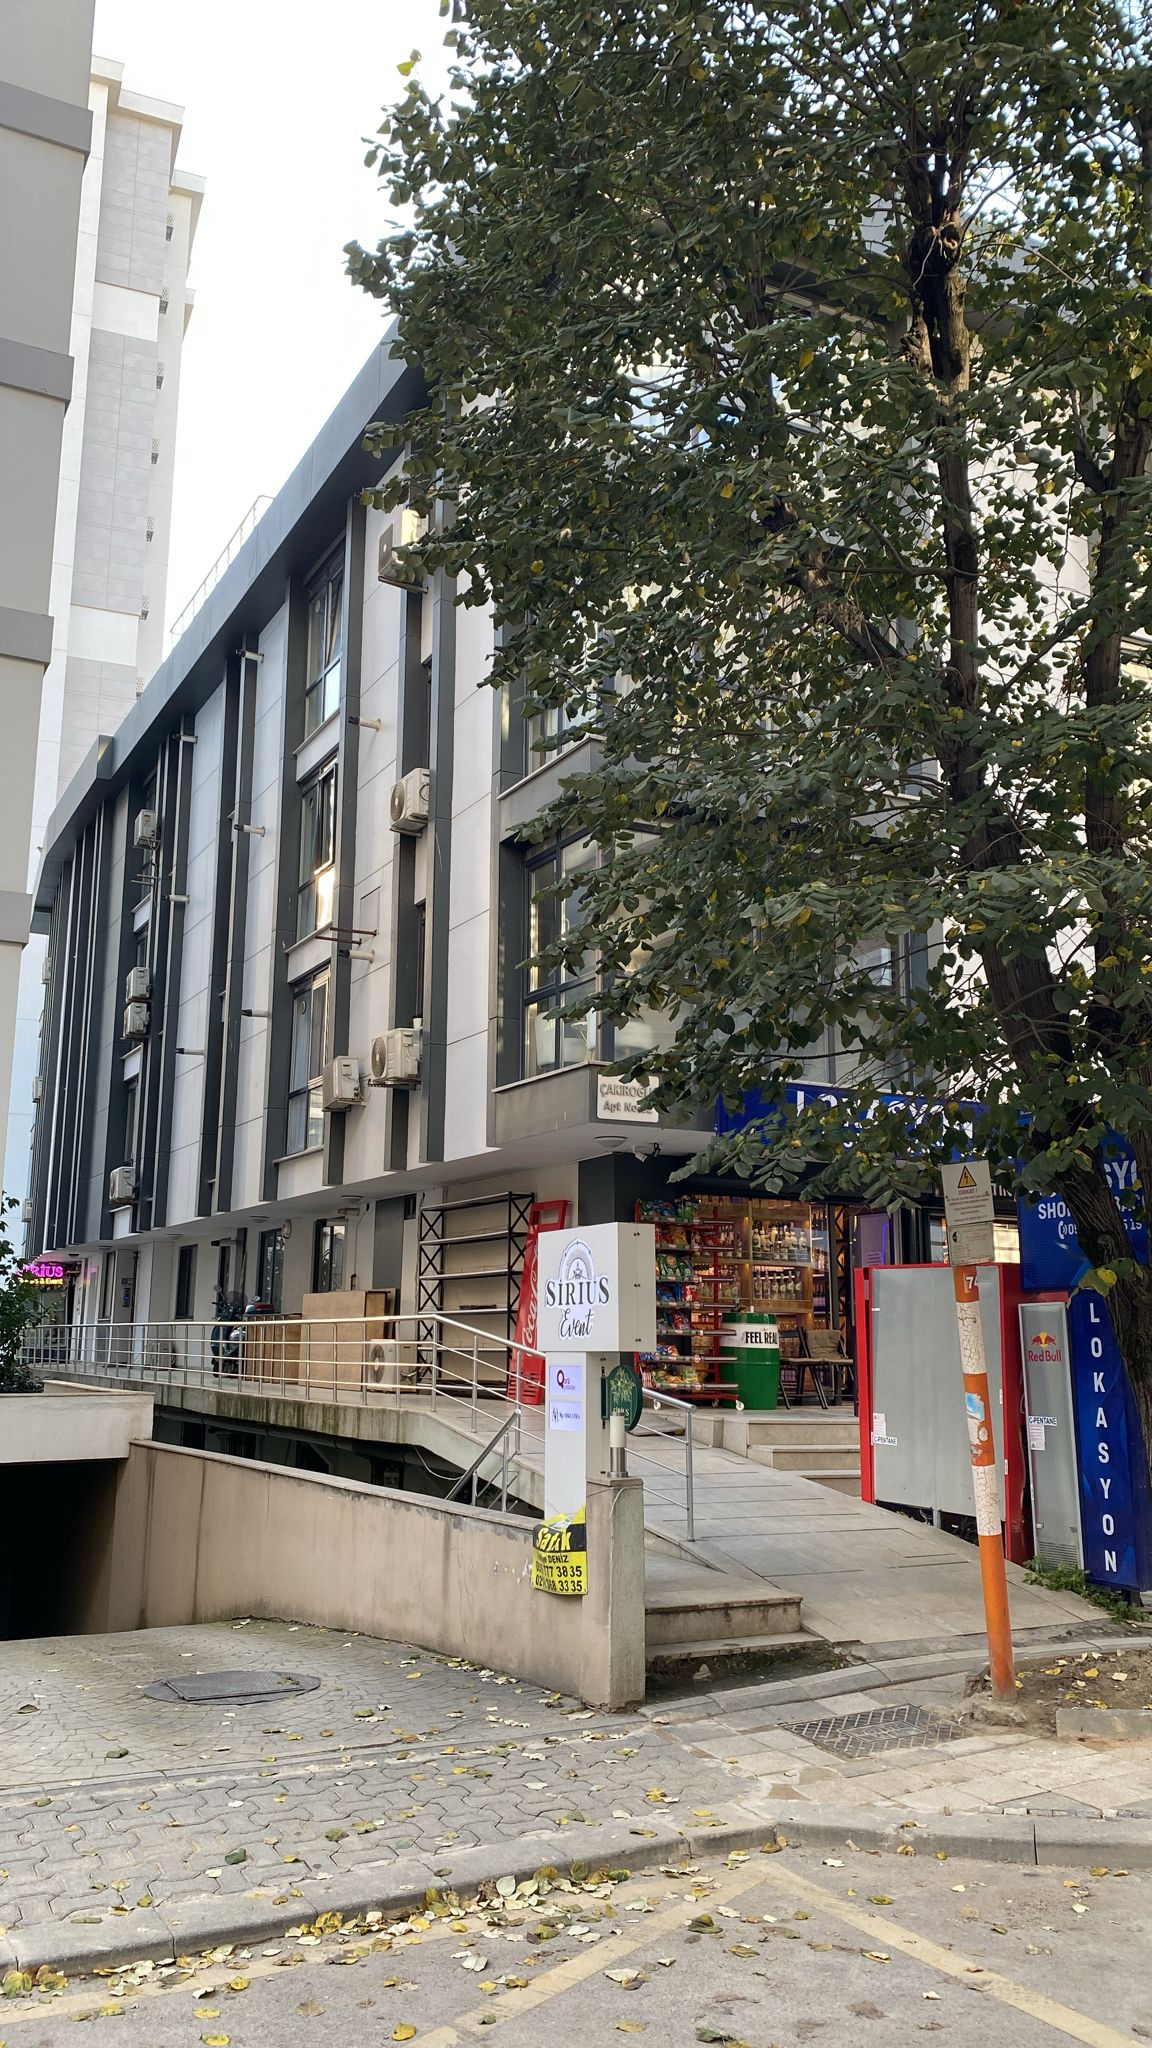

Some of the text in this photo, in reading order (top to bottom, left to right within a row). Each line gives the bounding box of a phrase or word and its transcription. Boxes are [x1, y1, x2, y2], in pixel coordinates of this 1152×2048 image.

[603, 1100, 621, 1113] Apt
[560, 1307, 595, 1338] Event
[745, 1331, 763, 1344] FEEL
[1028, 1350, 1062, 1363] Red Bull
[1089, 1303, 1118, 1573] LOKASYON
[555, 1565, 568, 1578] 38
[569, 1565, 583, 1578] 35
[570, 1580, 583, 1592] 35
